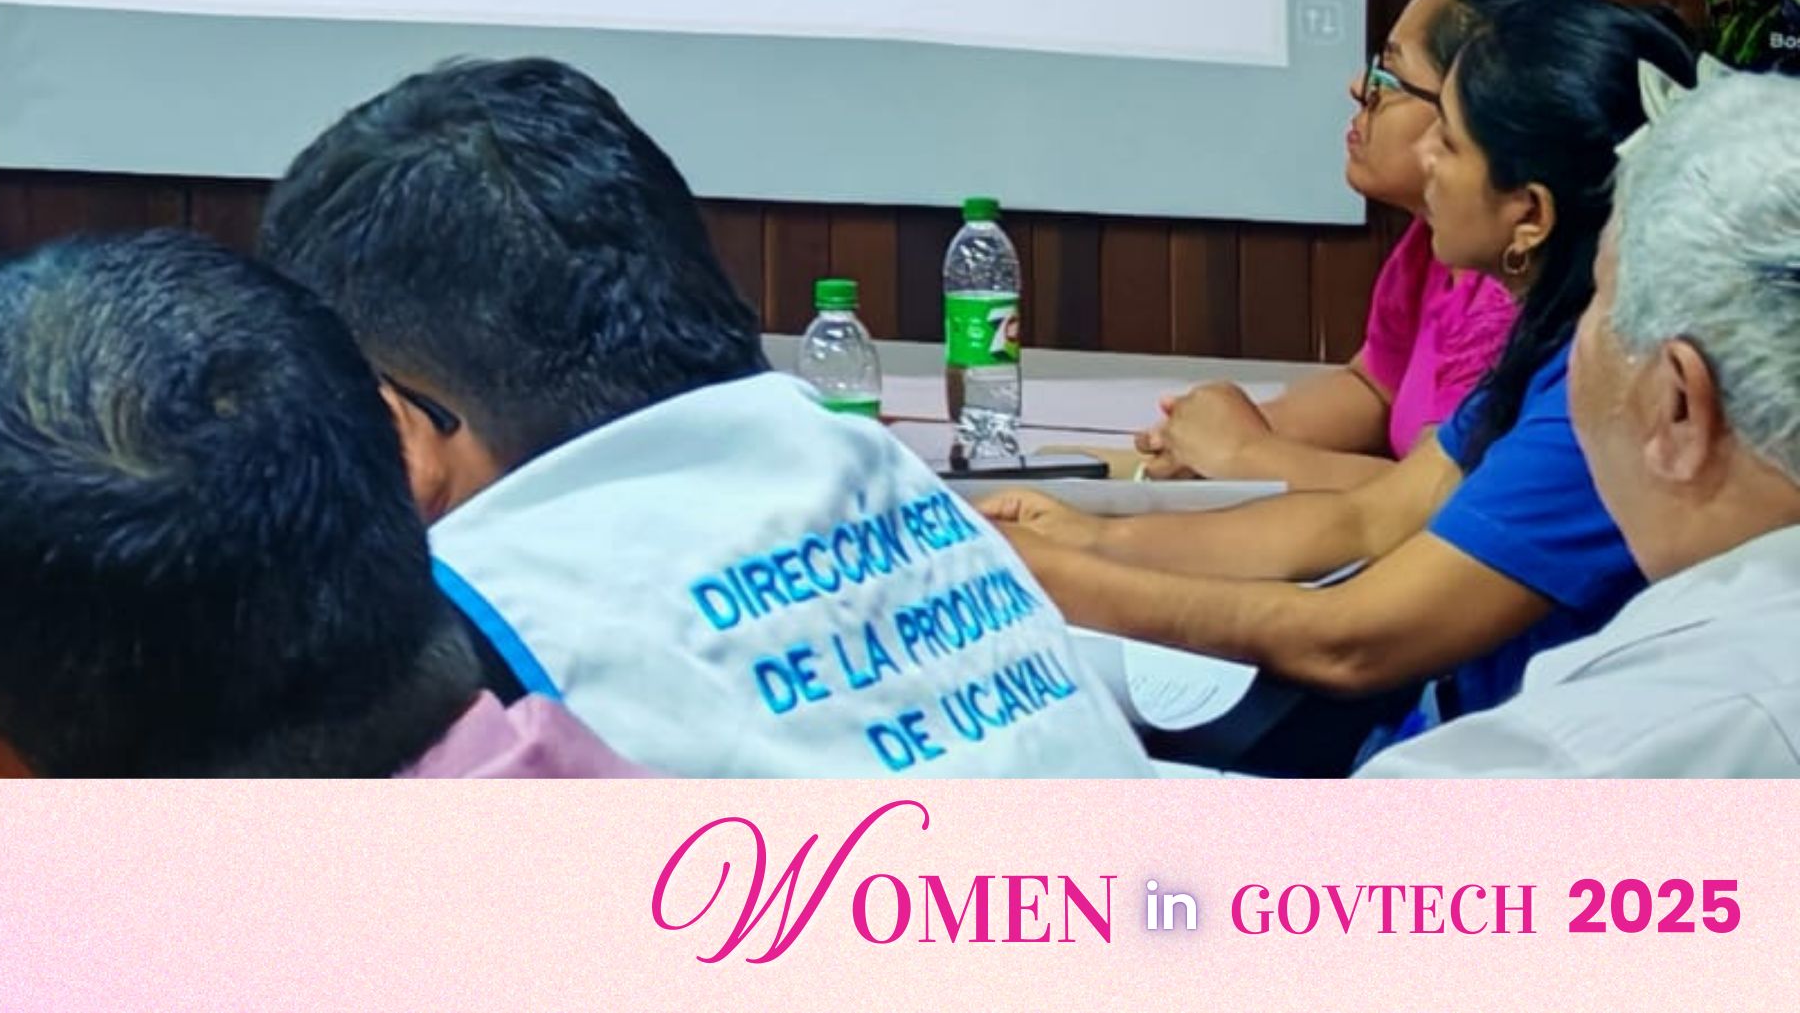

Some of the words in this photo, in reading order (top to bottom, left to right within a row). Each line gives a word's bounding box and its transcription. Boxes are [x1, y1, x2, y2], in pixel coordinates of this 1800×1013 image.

[753, 643, 832, 714] DE
[832, 622, 899, 690] LA
[865, 709, 947, 772] DE
